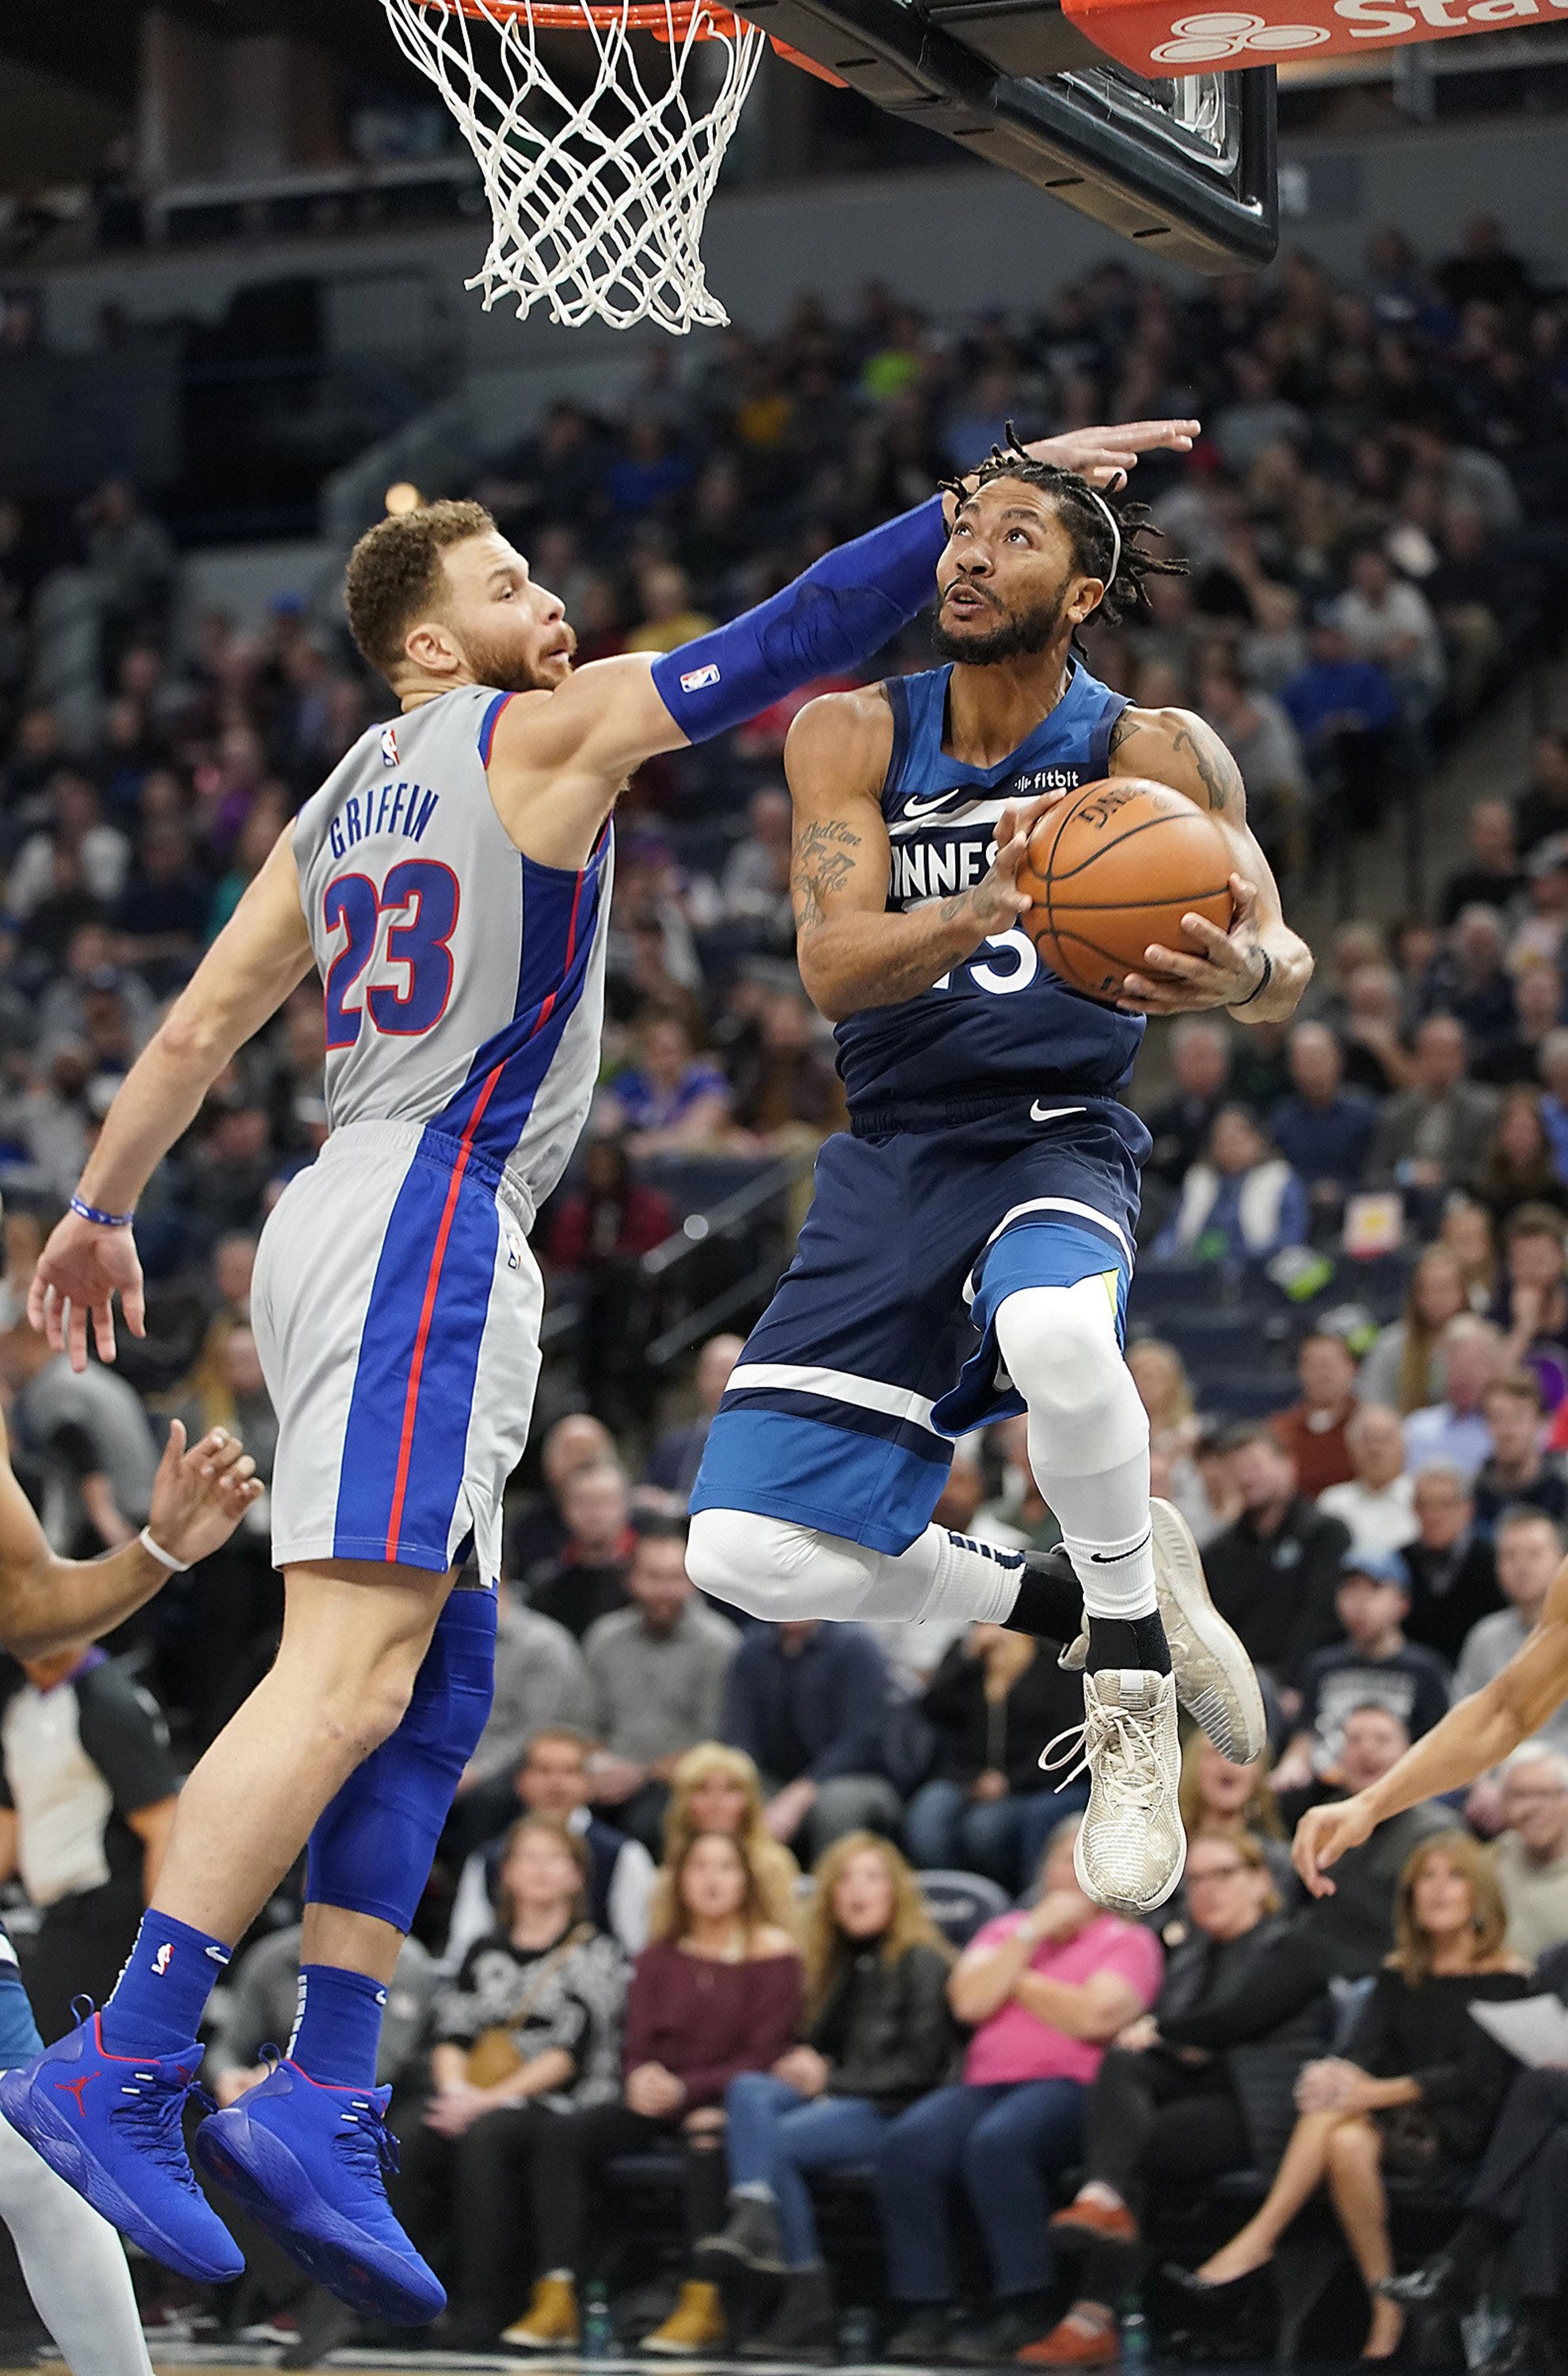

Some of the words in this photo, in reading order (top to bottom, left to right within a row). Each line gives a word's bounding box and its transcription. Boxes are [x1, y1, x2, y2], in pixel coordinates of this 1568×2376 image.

[1334, 0, 1568, 38] Sta
[1033, 769, 1079, 790] fitbit
[329, 782, 440, 860] GRIFFIN
[323, 858, 461, 1052] 23
